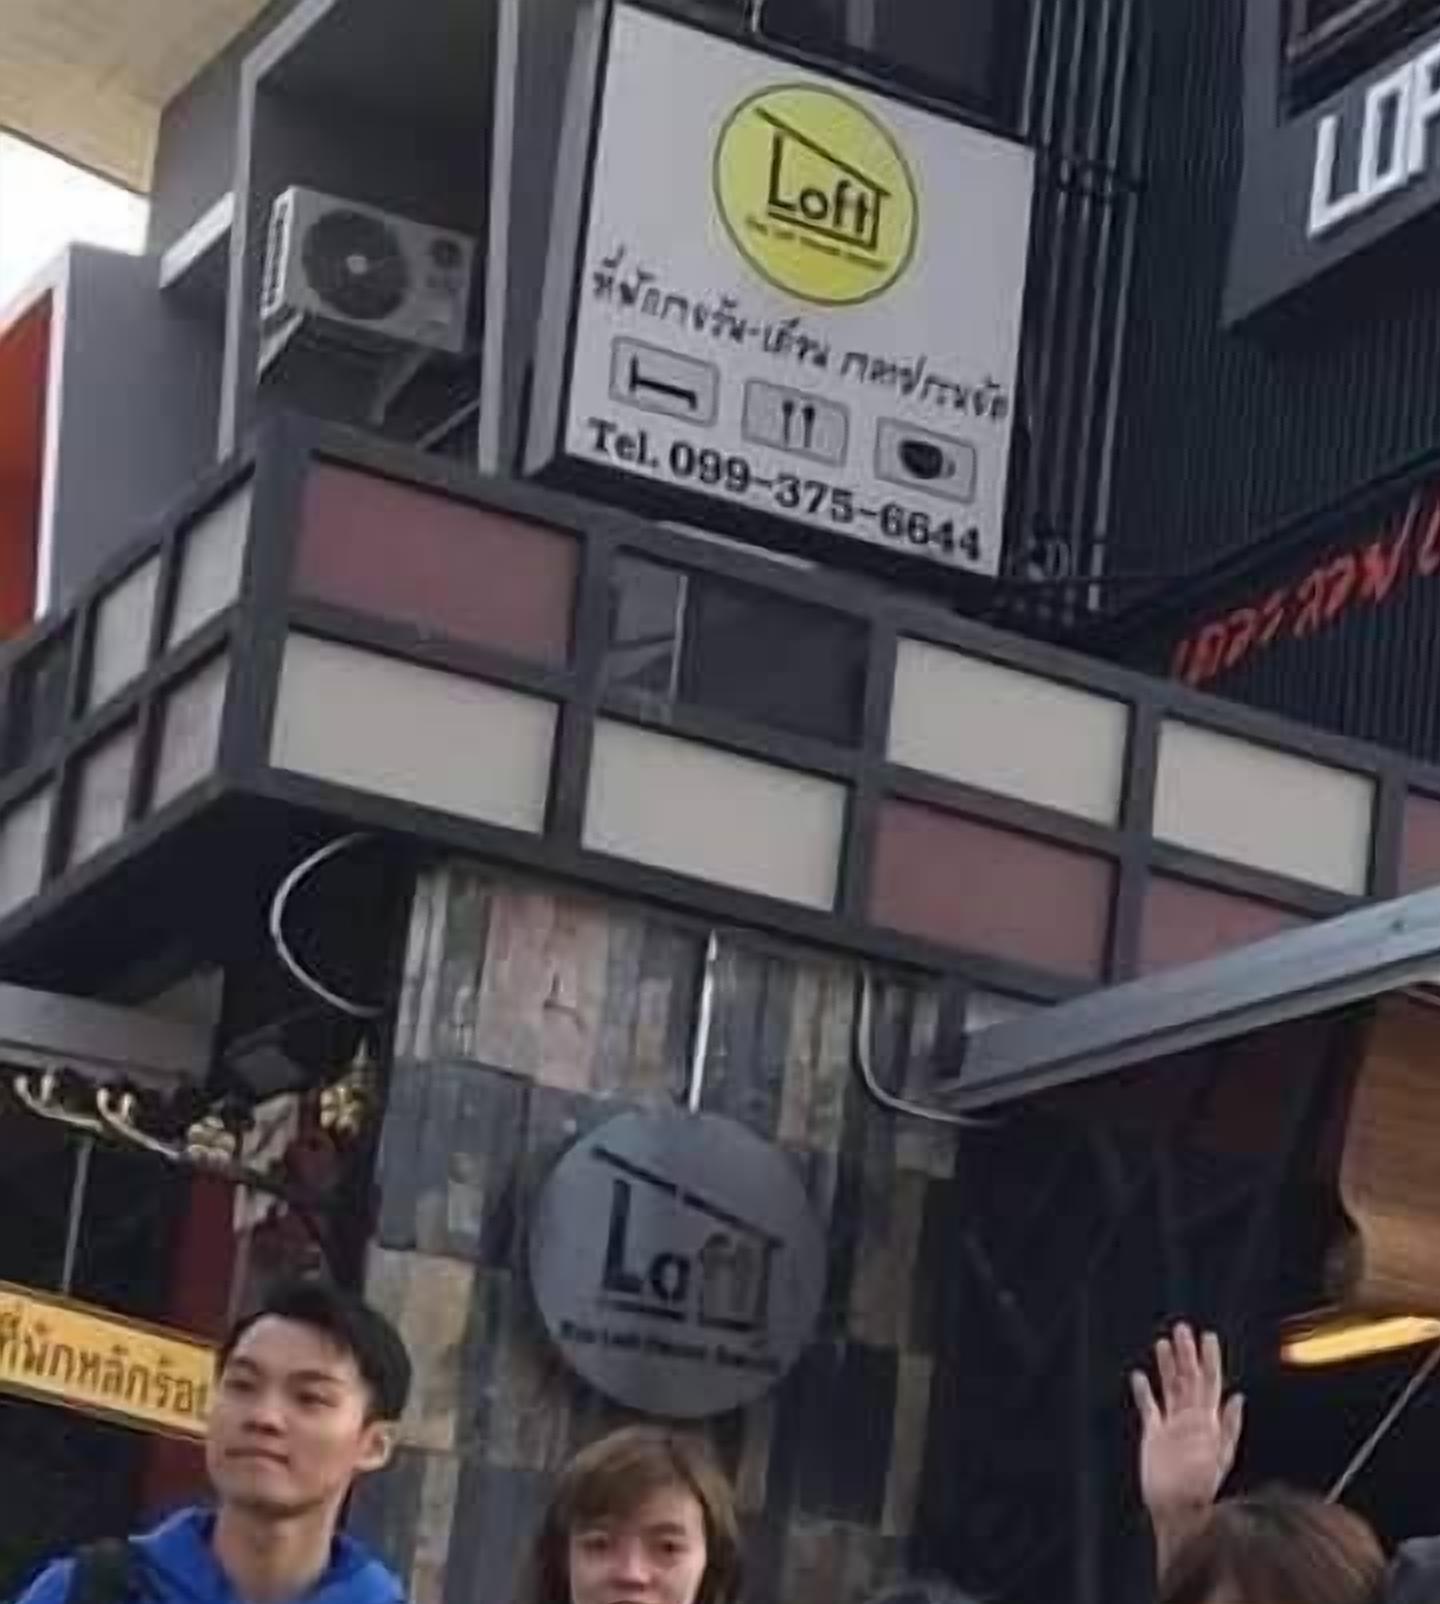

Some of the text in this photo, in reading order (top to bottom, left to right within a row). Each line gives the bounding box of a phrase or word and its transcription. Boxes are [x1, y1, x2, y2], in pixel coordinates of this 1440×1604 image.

[768, 131, 872, 236] Loft
[588, 417, 980, 561] Tel. 099-375-6644
